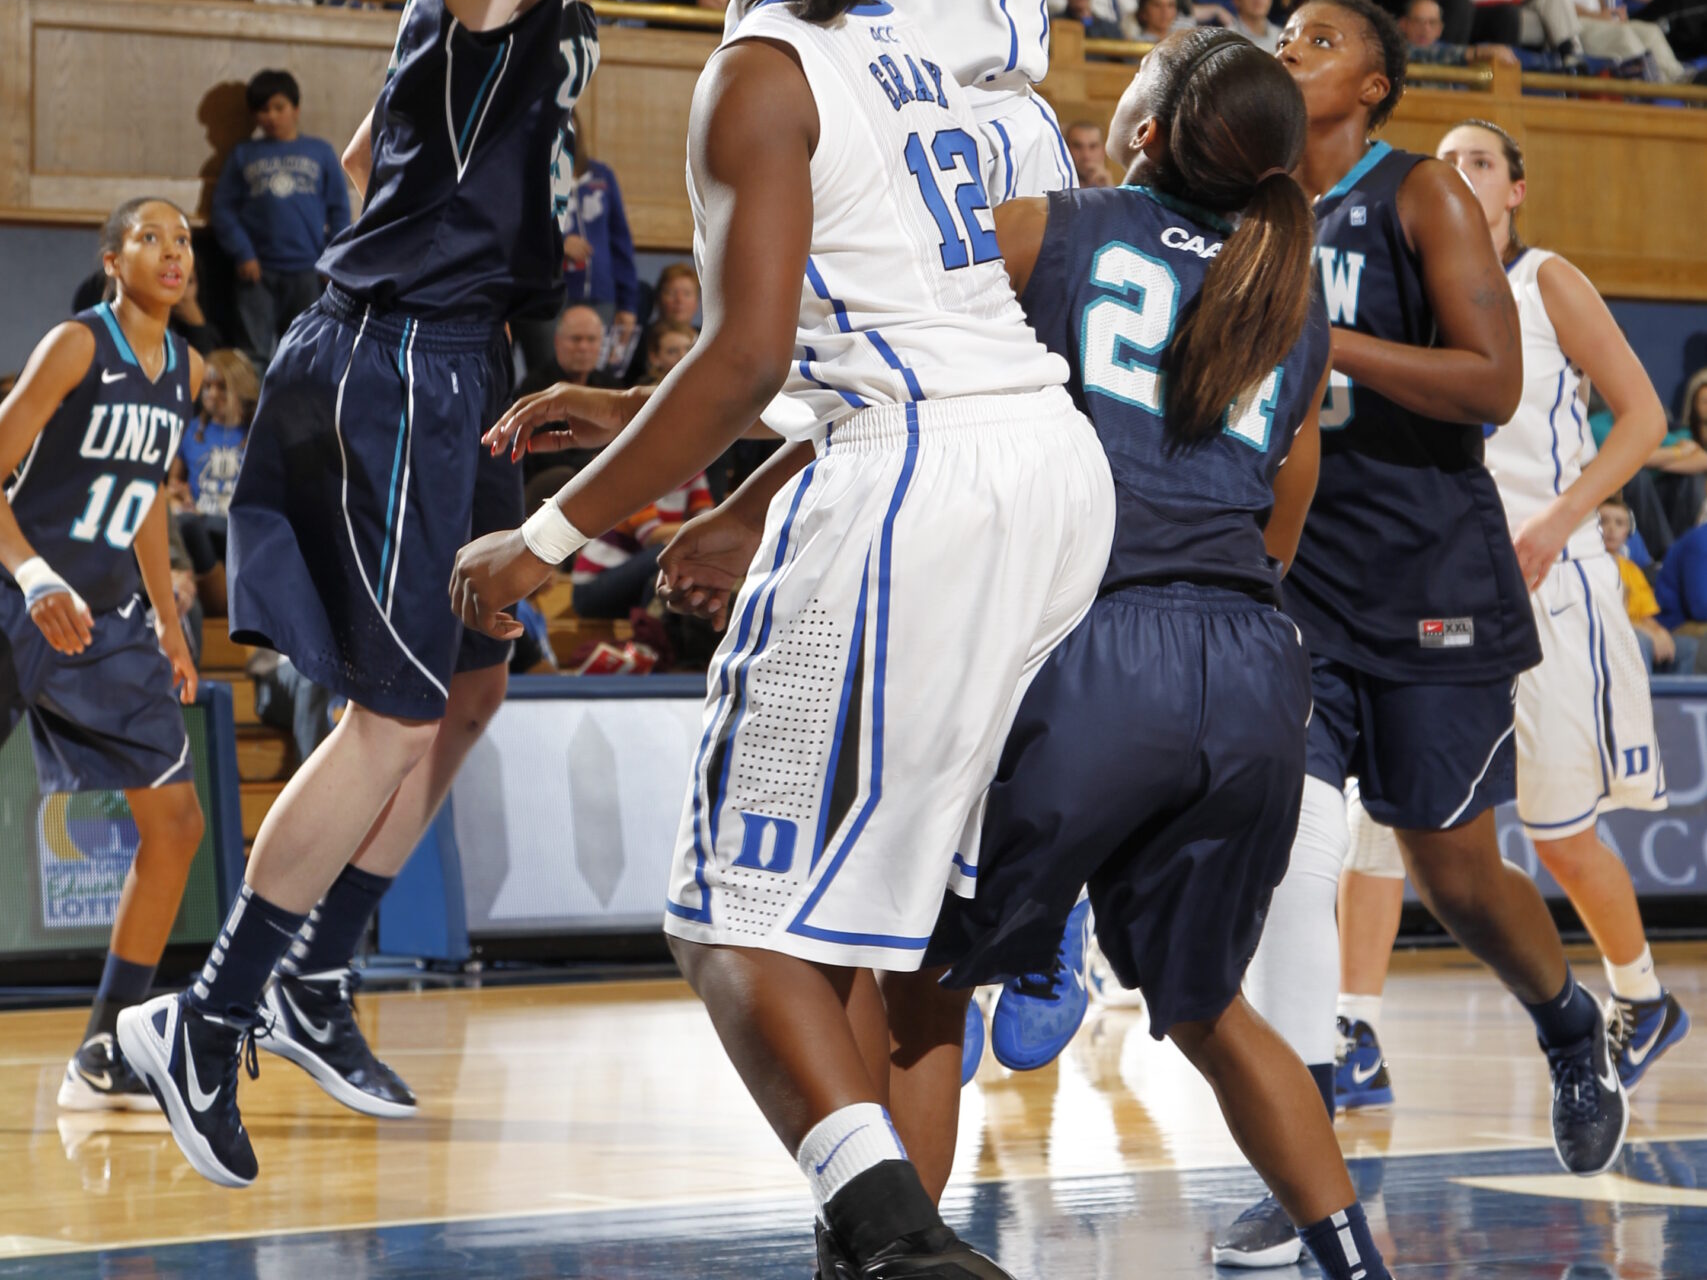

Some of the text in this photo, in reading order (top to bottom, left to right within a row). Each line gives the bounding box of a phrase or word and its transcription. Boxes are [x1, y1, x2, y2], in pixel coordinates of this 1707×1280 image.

[868, 53, 949, 112] GRAY
[904, 127, 1005, 271] 12
[69, 473, 157, 551] 10
[731, 809, 799, 875] D
